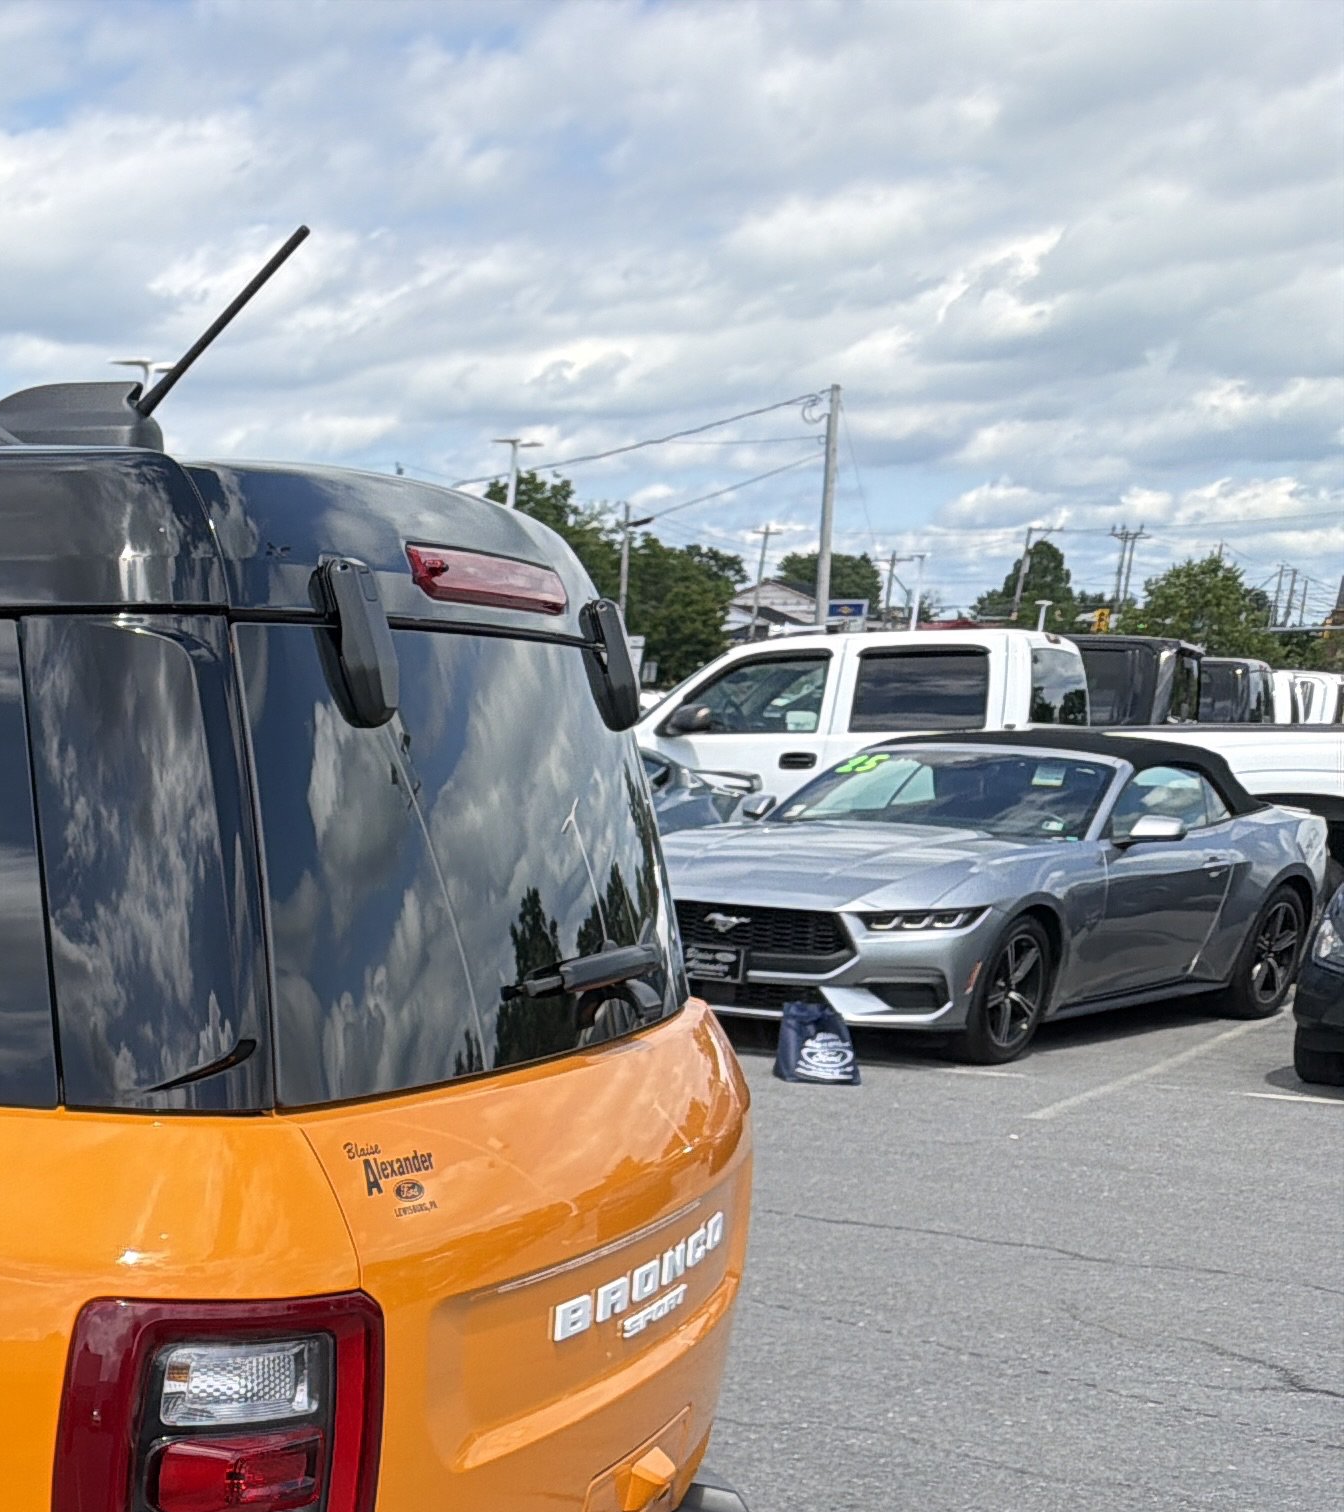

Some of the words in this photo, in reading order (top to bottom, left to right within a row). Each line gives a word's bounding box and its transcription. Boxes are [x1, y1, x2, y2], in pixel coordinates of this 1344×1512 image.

[343, 1142, 381, 1160] Blaise
[363, 1150, 434, 1197] Alexander
[554, 1211, 724, 1342] BRONCO
[623, 1283, 688, 1339] SPORT
